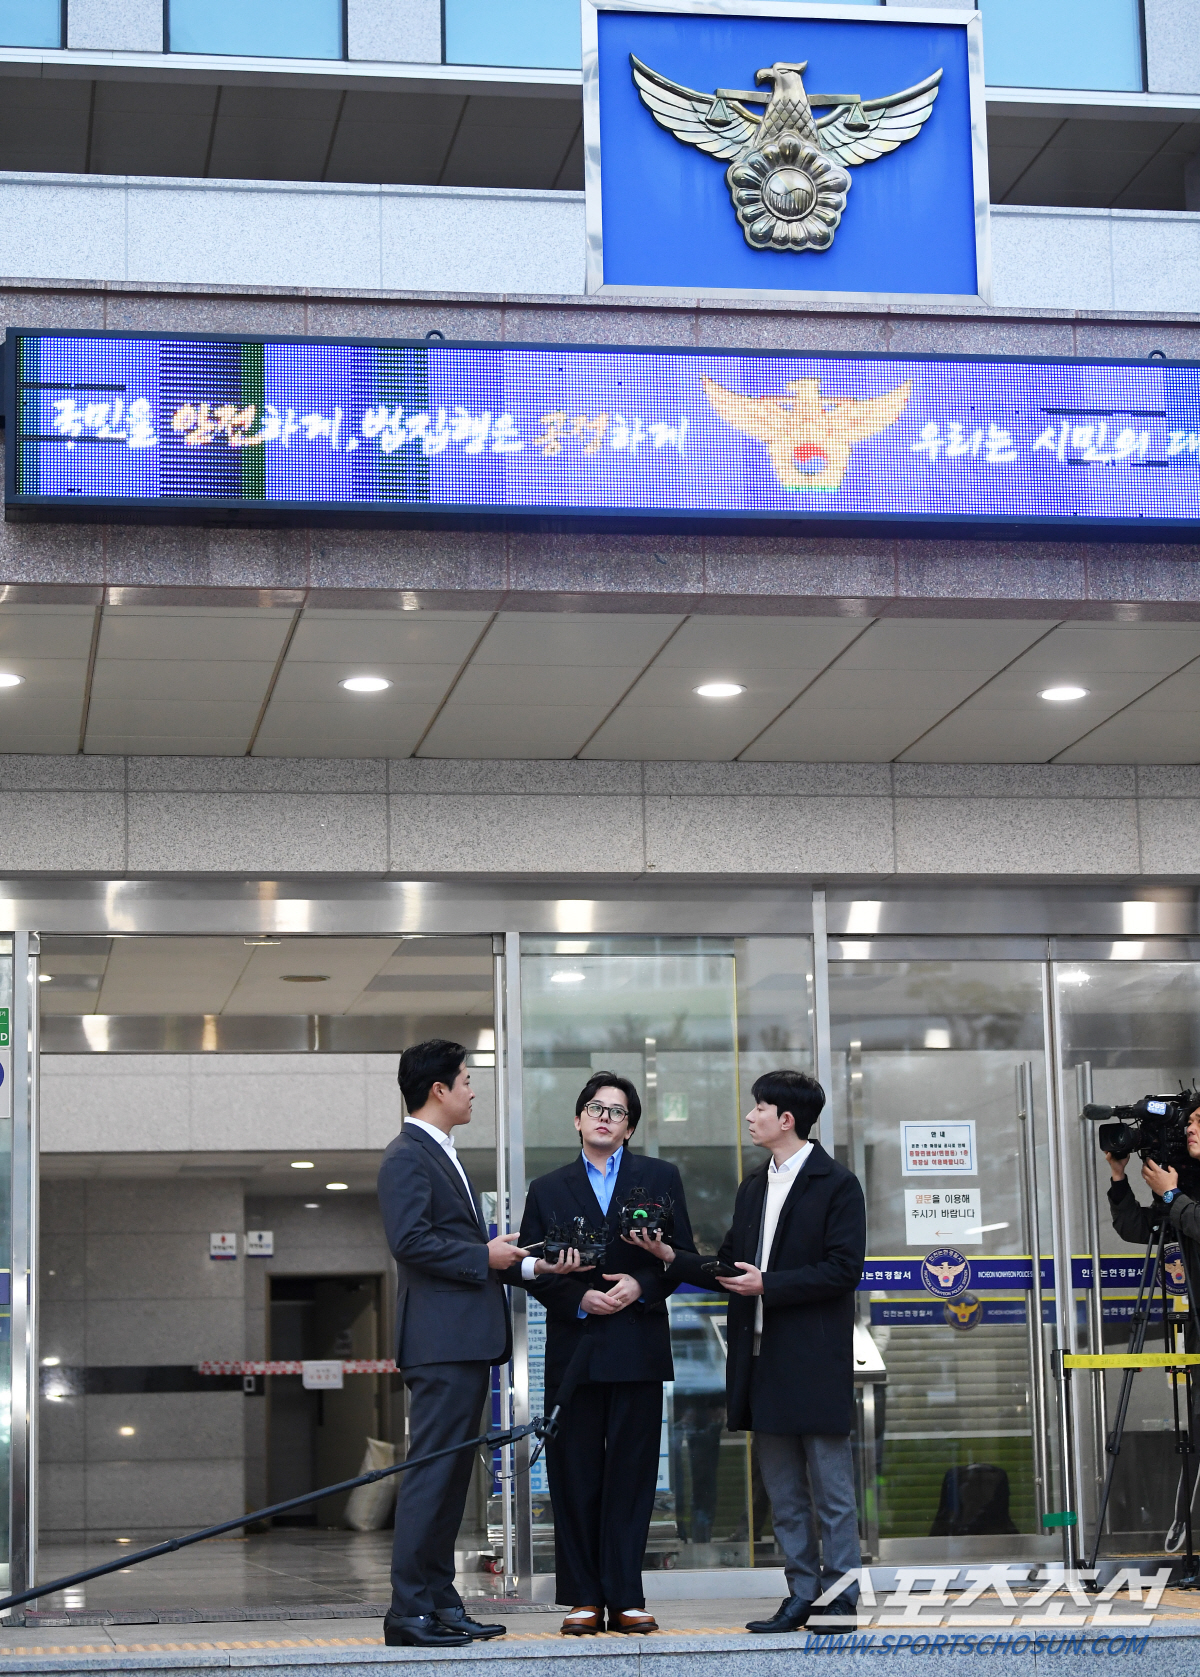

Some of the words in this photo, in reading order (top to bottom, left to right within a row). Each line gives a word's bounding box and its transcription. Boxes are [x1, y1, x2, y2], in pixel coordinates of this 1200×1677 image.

[52, 397, 158, 449] 국민을
[533, 411, 688, 458] 공정하게
[910, 421, 1018, 462] 우리는
[1032, 420, 1150, 462] 시민의
[915, 1194, 940, 1204] 옆문을
[944, 1194, 970, 1204] 이용해
[912, 1209, 937, 1218] 주시기
[941, 1209, 975, 1218] 바랍니다
[1081, 1268, 1144, 1278] 인논현경찰서
